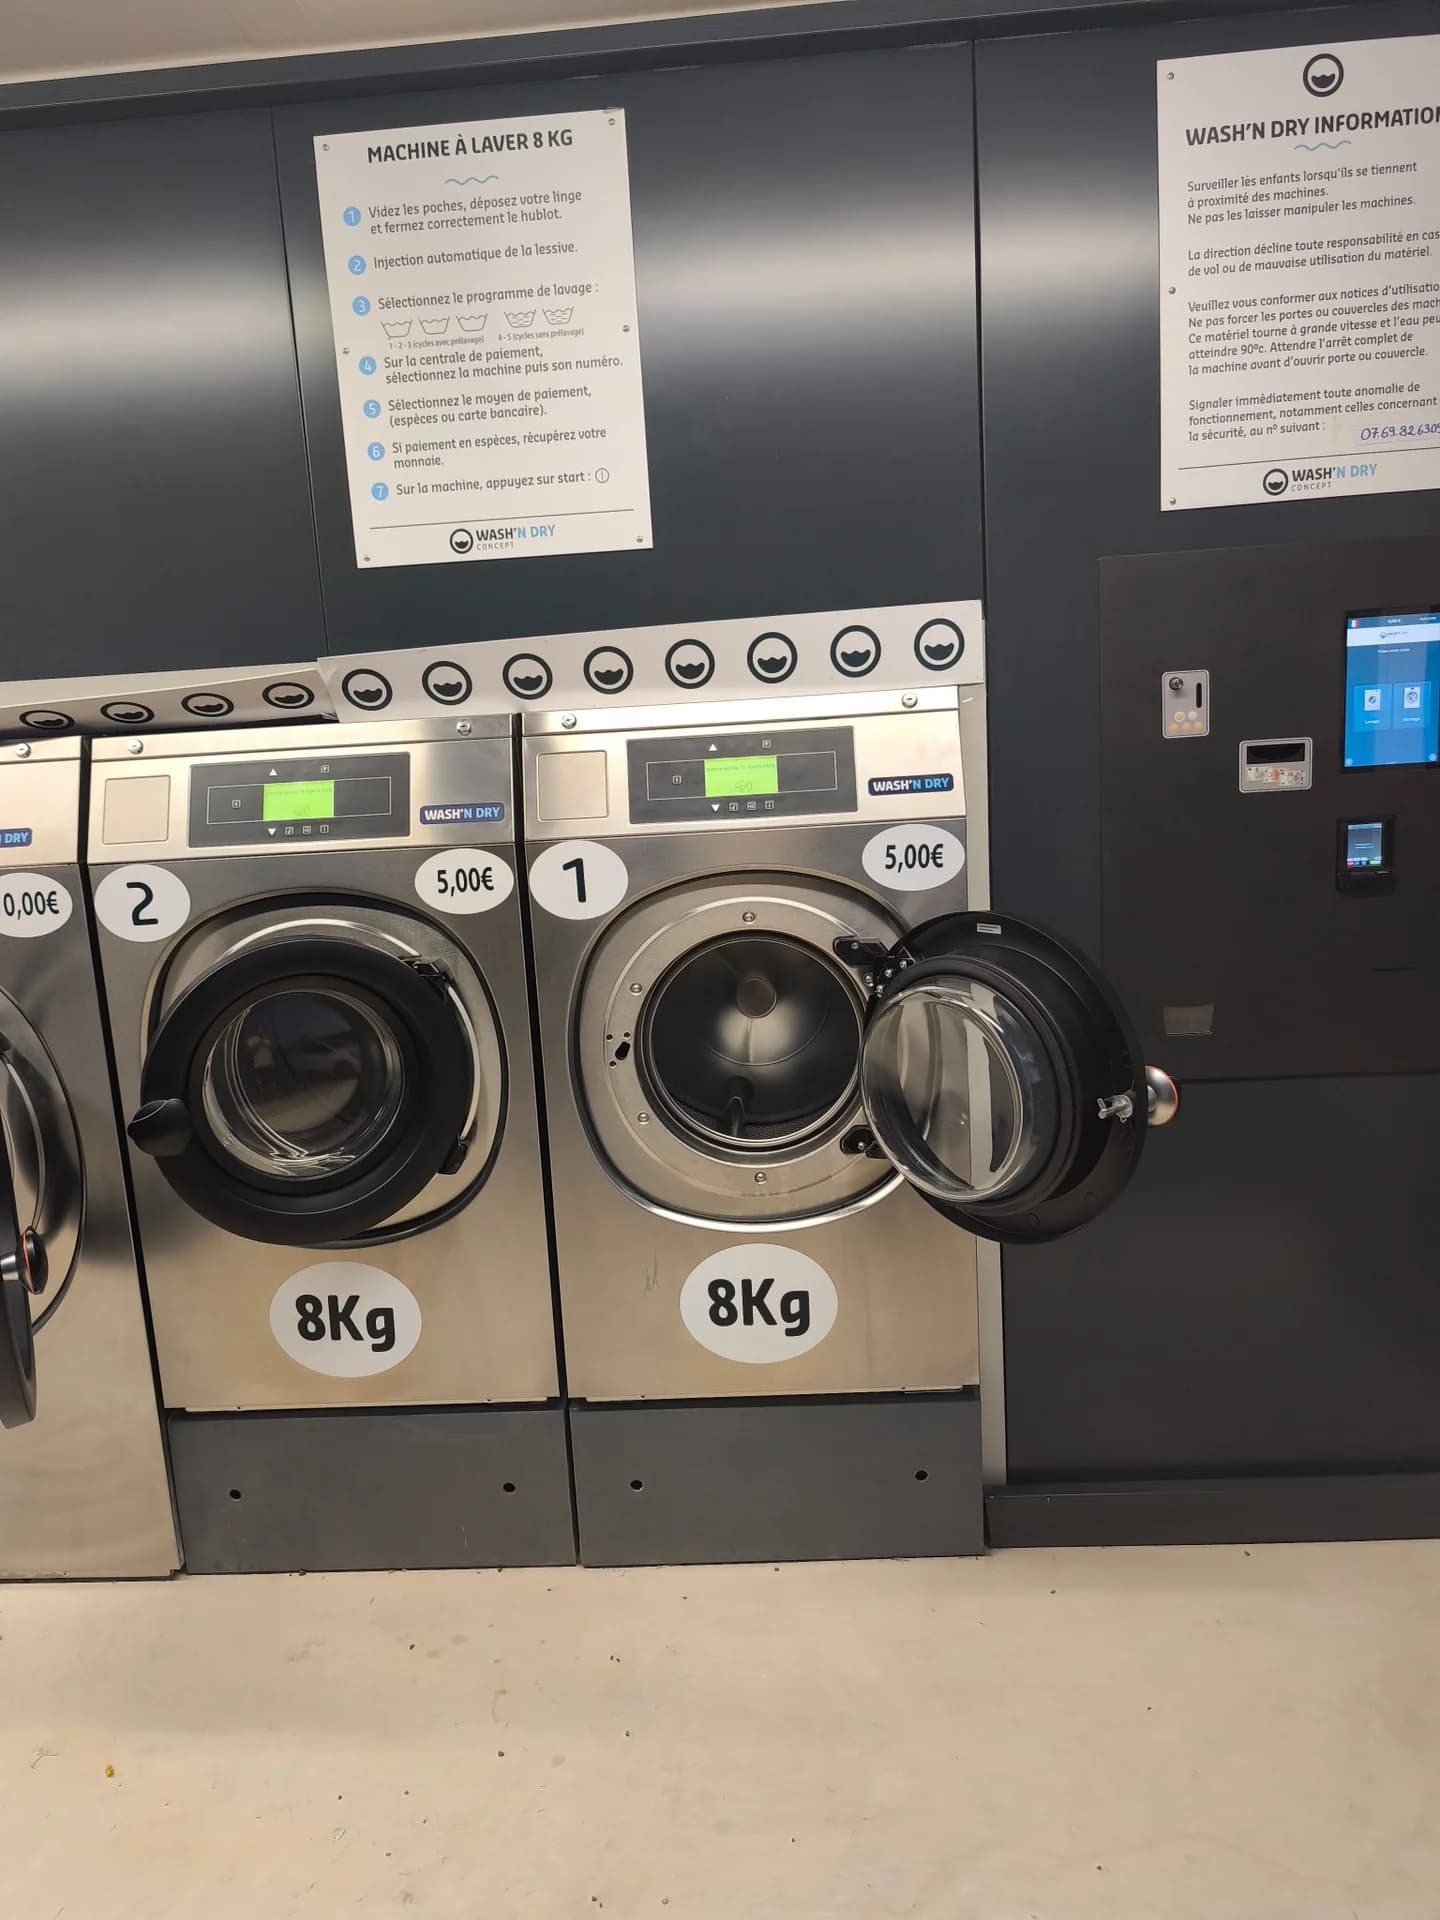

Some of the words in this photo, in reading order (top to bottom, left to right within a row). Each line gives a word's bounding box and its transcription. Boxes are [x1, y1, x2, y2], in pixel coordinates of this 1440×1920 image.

[1186, 122, 1265, 145] WASH'N
[1272, 118, 1309, 138] DRY
[368, 140, 450, 163] MACHINE
[456, 134, 467, 155] À
[472, 134, 528, 153] LAVER
[533, 132, 543, 148] 8
[548, 129, 572, 147] KG
[1188, 178, 1239, 191] Surveiller
[1260, 173, 1300, 185] enfants
[1304, 167, 1353, 181] lorsqu'ils
[1371, 162, 1416, 175] tiennent
[368, 206, 400, 218] Videz
[403, 204, 419, 215] les
[423, 200, 466, 216] poches,
[470, 197, 517, 212] déposez
[520, 194, 549, 205] votre
[552, 191, 581, 204] linge
[1188, 214, 1202, 224] Ne
[1206, 213, 1224, 224] pas
[1227, 210, 1242, 221] les
[1245, 208, 1281, 219] laisser
[1284, 202, 1339, 215] manipuler
[1342, 200, 1357, 210] les
[1361, 196, 1415, 208] machines.
[1198, 192, 1248, 209] proximité
[1252, 192, 1270, 202] des
[1274, 187, 1328, 200] machines.
[385, 222, 424, 232] fermez
[428, 214, 504, 229] correctement
[521, 208, 562, 221] hublot.
[374, 254, 423, 270] Injection
[427, 249, 501, 264] automatique
[505, 246, 518, 257] de
[535, 242, 577, 255] lessive.
[1189, 250, 1200, 260] La
[1204, 247, 1250, 259] direction
[1254, 243, 1292, 254] décline
[1295, 240, 1323, 251] toute
[1327, 232, 1403, 249] responsabilité
[1422, 231, 1439, 240] cas
[1204, 264, 1219, 275] vol
[1239, 261, 1251, 272] de
[1255, 257, 1306, 270] mauvaise
[1310, 253, 1364, 265] utilisation
[1368, 251, 1381, 261] du
[1385, 246, 1431, 259] matériel.
[378, 296, 450, 309] Sélectionnez
[467, 289, 533, 304] programme
[537, 285, 550, 296] de
[553, 284, 592, 296] lavage
[1188, 300, 1229, 312] Veuillez
[1233, 299, 1257, 308] vous
[1261, 294, 1315, 305] conformer
[1319, 292, 1337, 301] aux
[1341, 288, 1378, 299] notices
[1189, 318, 1202, 328] Ne
[1206, 317, 1224, 328] pas
[1228, 314, 1258, 324] forcer
[1261, 312, 1276, 321] les
[1280, 310, 1312, 322] portes
[1332, 303, 1388, 315] couvercles
[1391, 301, 1409, 310] des
[1189, 333, 1201, 343] Ce
[1205, 329, 1249, 342] matériel
[1252, 328, 1287, 338] tourne
[1300, 322, 1337, 336] grande
[1340, 320, 1377, 330] vitesse
[1394, 316, 1419, 326] l'eau
[384, 357, 403, 368] Sur
[420, 352, 465, 365] centrale
[469, 350, 482, 361] de
[486, 346, 543, 365] paiement,
[1189, 346, 1237, 359] atteindre
[1270, 340, 1316, 352] Attendre
[1319, 336, 1352, 348] l'arrêt
[1355, 333, 1397, 346] complet
[386, 370, 456, 384] sélectionnez
[458, 367, 469, 378] la
[473, 364, 521, 377] machine
[525, 361, 548, 375] puis
[552, 361, 571, 371] son
[576, 355, 623, 369] numéro.
[1202, 362, 1247, 373] machine
[1251, 359, 1281, 369] avant
[1284, 354, 1325, 367] d'ouvrir
[1328, 353, 1355, 365] porte
[388, 398, 459, 411] Sélectionnez
[476, 393, 514, 405] moyen
[518, 390, 530, 401] de
[534, 386, 591, 405] paiement,
[1189, 398, 1233, 412] Signaler
[1235, 390, 1321, 406] immédiatement
[1324, 389, 1351, 398] toute
[1355, 384, 1404, 396] anomalie
[1189, 410, 1276, 425] fonctionnement,
[1280, 404, 1342, 417] notamment
[1345, 401, 1374, 412] celles
[1378, 397, 1437, 410] concernant
[390, 414, 438, 428] (espèces
[441, 413, 455, 422] ou
[459, 410, 487, 421] carte
[490, 404, 546, 419] bancaire).
[392, 442, 402, 453] Si
[405, 439, 456, 455] paiement
[475, 434, 520, 448] espèces,
[523, 430, 576, 444] récupérez
[578, 428, 606, 439] votre
[1202, 427, 1246, 440] sécurité,
[1280, 422, 1320, 433] suivant
[394, 455, 443, 468] monnaie.
[1292, 467, 1344, 481] WASH'N
[1351, 464, 1377, 477] DRY
[396, 484, 415, 495] Sur
[432, 480, 482, 492] machine,
[486, 477, 534, 490] appuyez
[537, 476, 555, 485] sur
[558, 472, 585, 483] start
[1291, 482, 1332, 491] CONCEPT
[476, 528, 525, 541] WASH'N
[530, 525, 555, 537] DRY
[477, 541, 513, 550] CONCEPT
[873, 778, 922, 793] WASH'N
[925, 776, 950, 790] DRY
[424, 807, 473, 822] WASH'N
[476, 805, 500, 820] DRY
[4, 832, 28, 844] DRY
[885, 844, 944, 873] 5,00€
[437, 866, 495, 897] 5,00€
[562, 857, 587, 903] 1
[3, 890, 60, 920] 0,00€
[126, 881, 159, 926] 2
[707, 1278, 810, 1337] 8Kg
[296, 1294, 396, 1353] 8Kg
